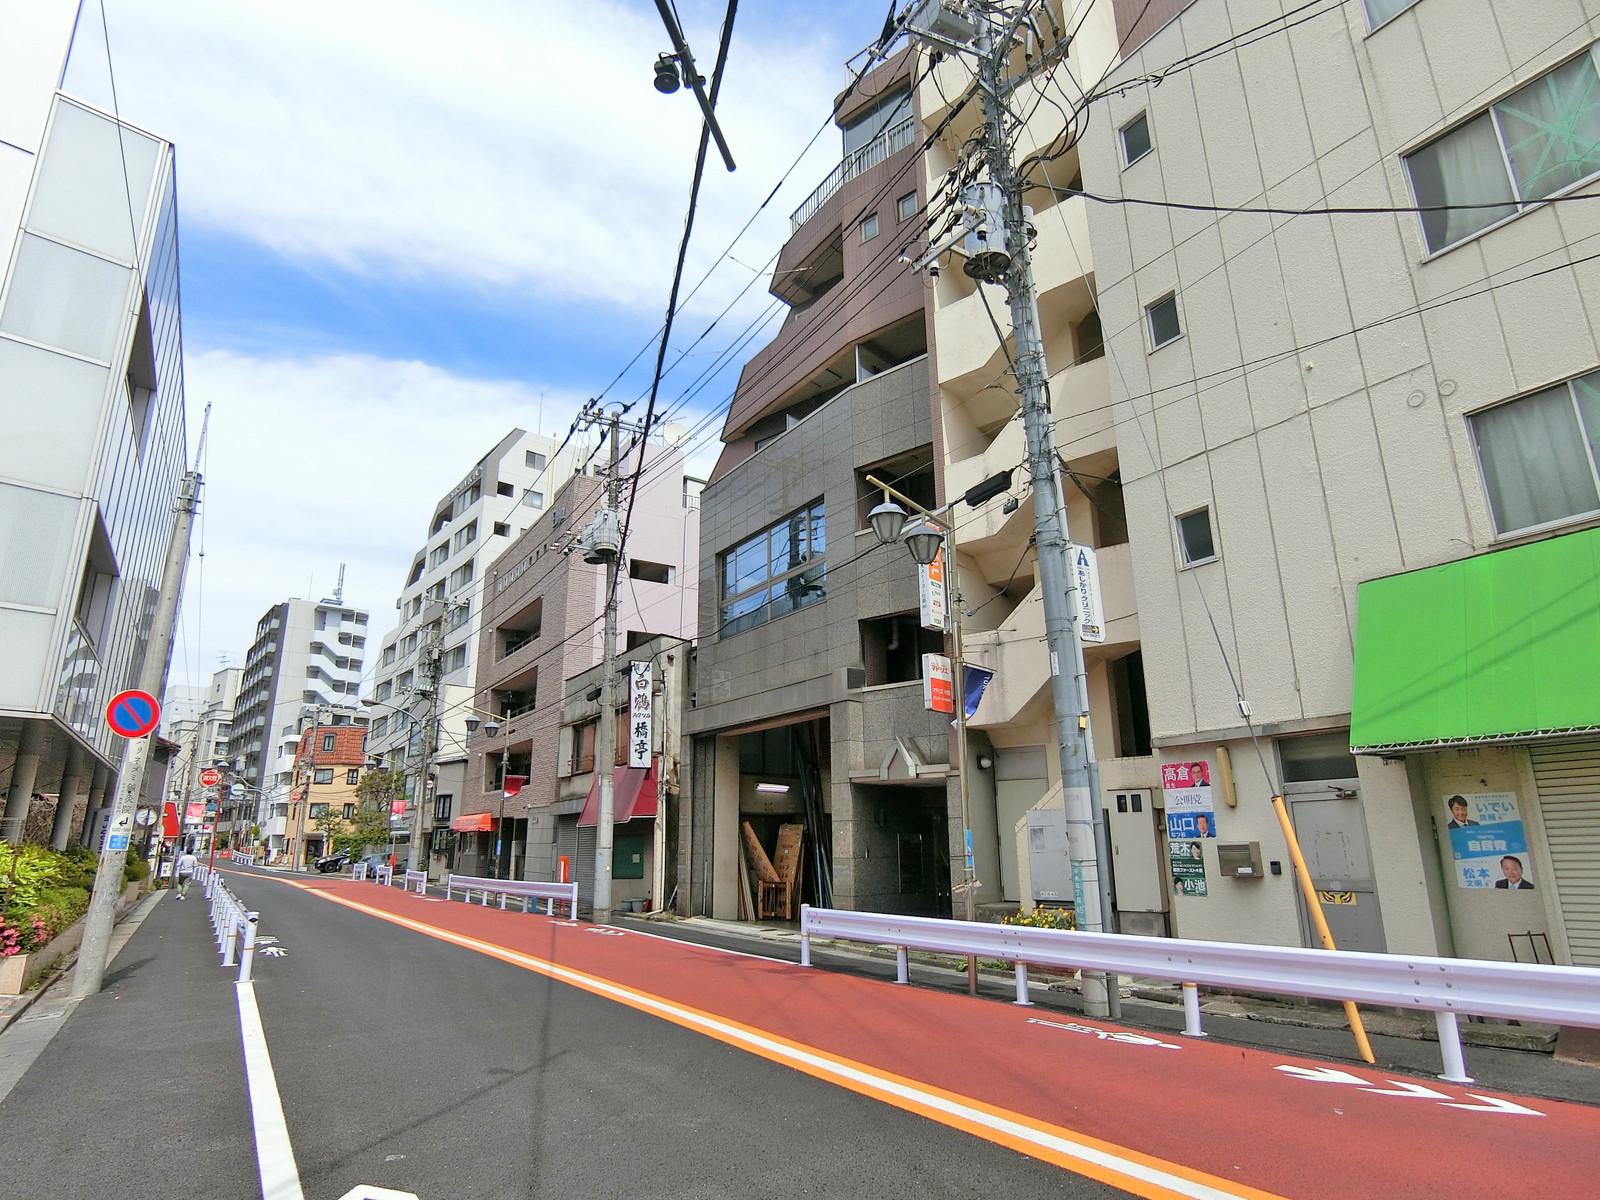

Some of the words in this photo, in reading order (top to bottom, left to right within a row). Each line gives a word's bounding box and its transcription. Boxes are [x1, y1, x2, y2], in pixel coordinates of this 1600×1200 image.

[931, 664, 949, 674] マドリエ
[634, 721, 649, 760] 橋亭
[1163, 766, 1190, 782] 高倉
[1174, 793, 1203, 806] 公明党
[1475, 802, 1516, 813] いでい
[1169, 817, 1195, 831] 山口
[1169, 842, 1190, 854] 荒木
[1468, 839, 1508, 852] 自民党
[1462, 867, 1491, 879] 松本
[1184, 878, 1206, 893] 小池
